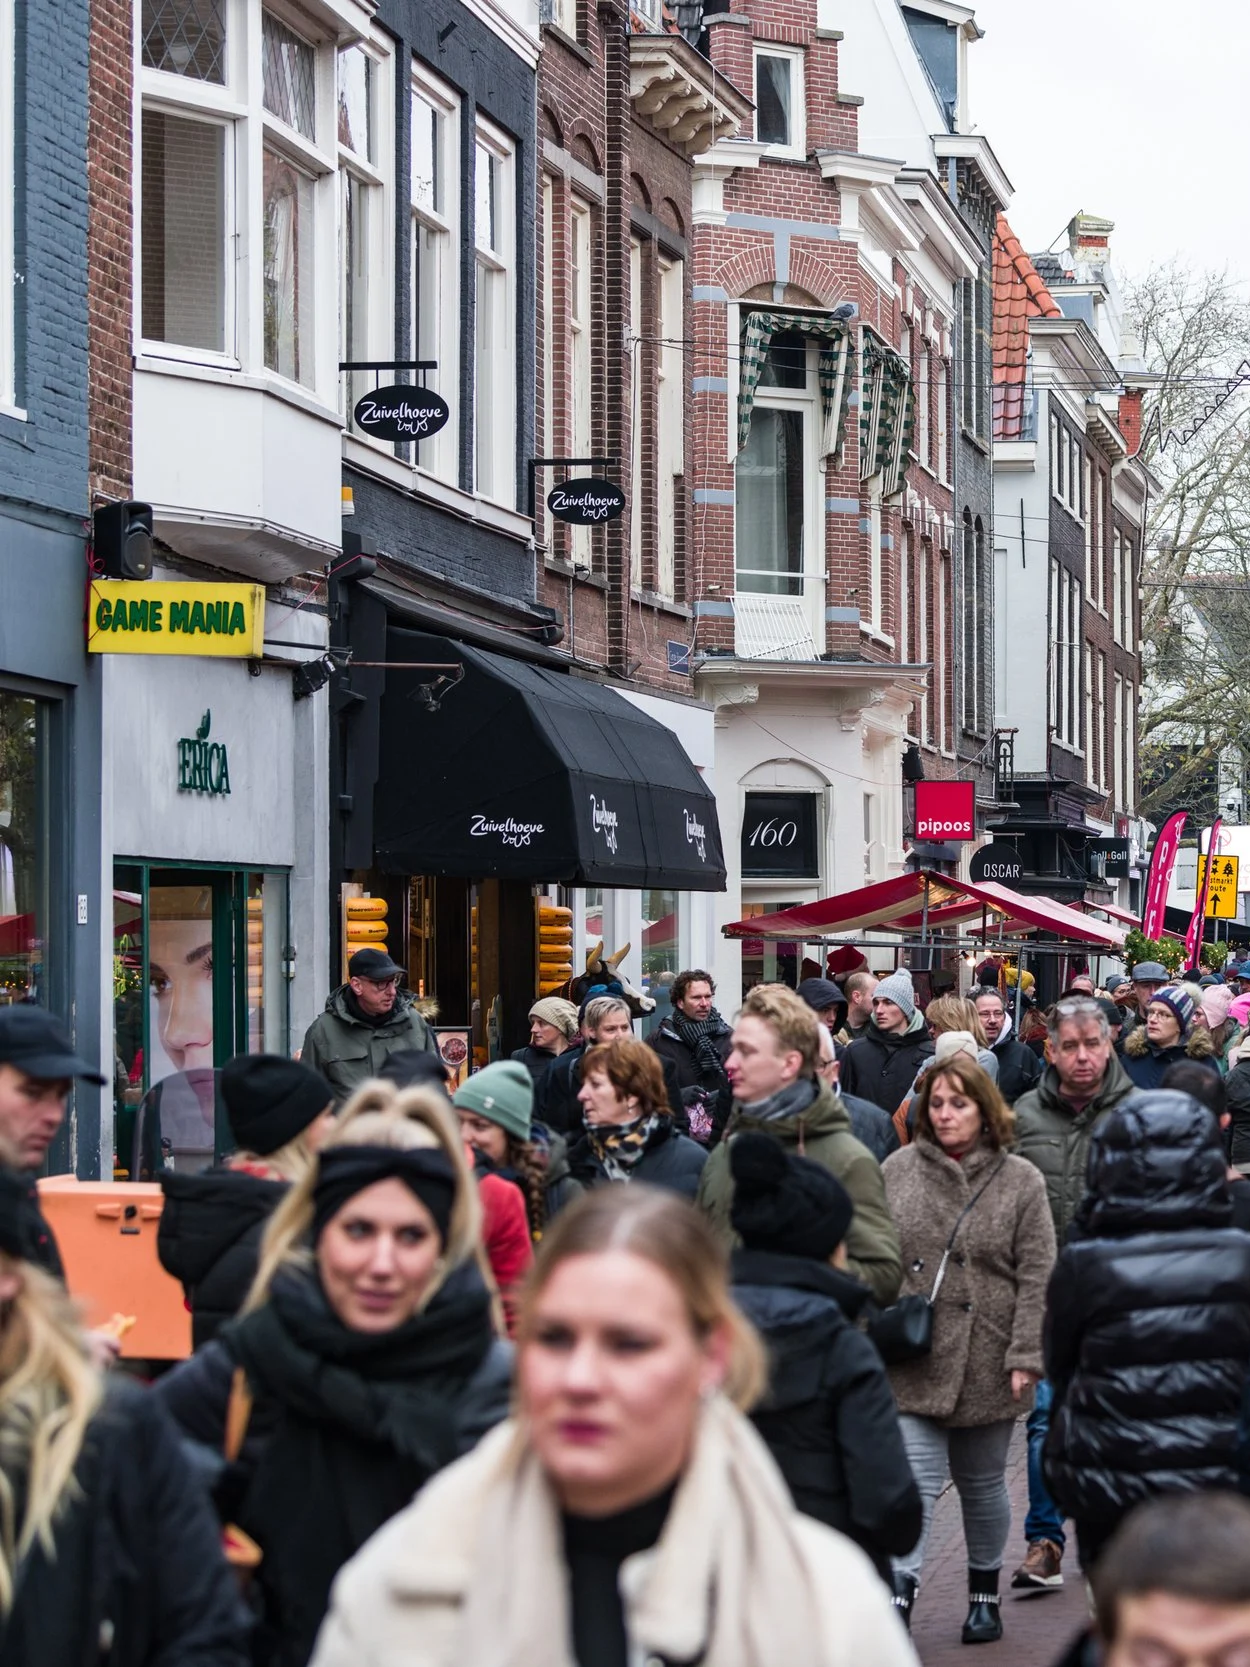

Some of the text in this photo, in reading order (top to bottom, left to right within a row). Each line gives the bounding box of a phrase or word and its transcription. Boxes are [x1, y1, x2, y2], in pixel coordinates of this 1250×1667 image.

[361, 401, 443, 424] Zuivelhoeve
[552, 491, 621, 510] Zuivelhoeve
[96, 599, 246, 635] GAME MANIA
[178, 738, 231, 794] ERICA
[470, 815, 545, 836] Zuivelhoeve
[749, 817, 797, 847] 160
[918, 818, 971, 835] pipoos
[983, 863, 1019, 878] OSCAR
